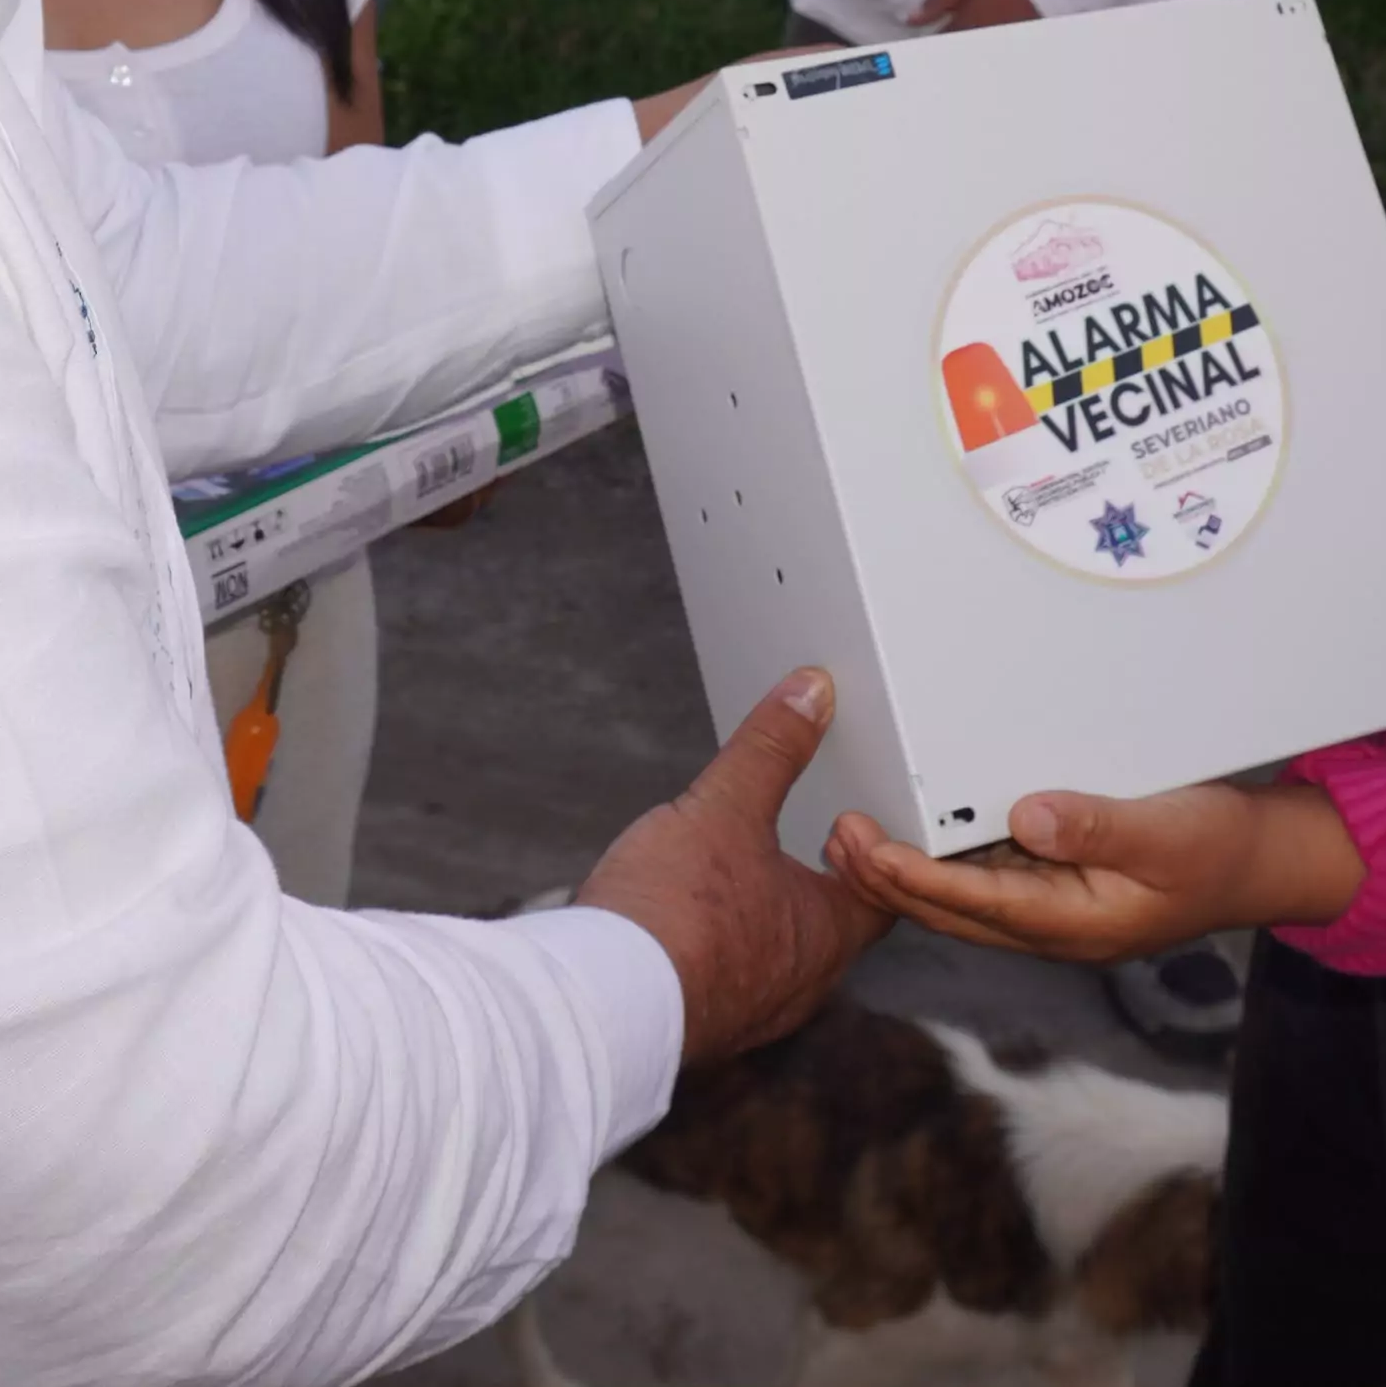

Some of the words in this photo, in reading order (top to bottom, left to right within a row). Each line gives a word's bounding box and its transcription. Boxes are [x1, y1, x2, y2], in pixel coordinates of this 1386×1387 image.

[1020, 272, 1233, 389] ALARMA
[1032, 273, 1115, 317] AMOZOC
[1040, 341, 1262, 454] VECINAL
[1130, 398, 1252, 460] SEVERIANO
